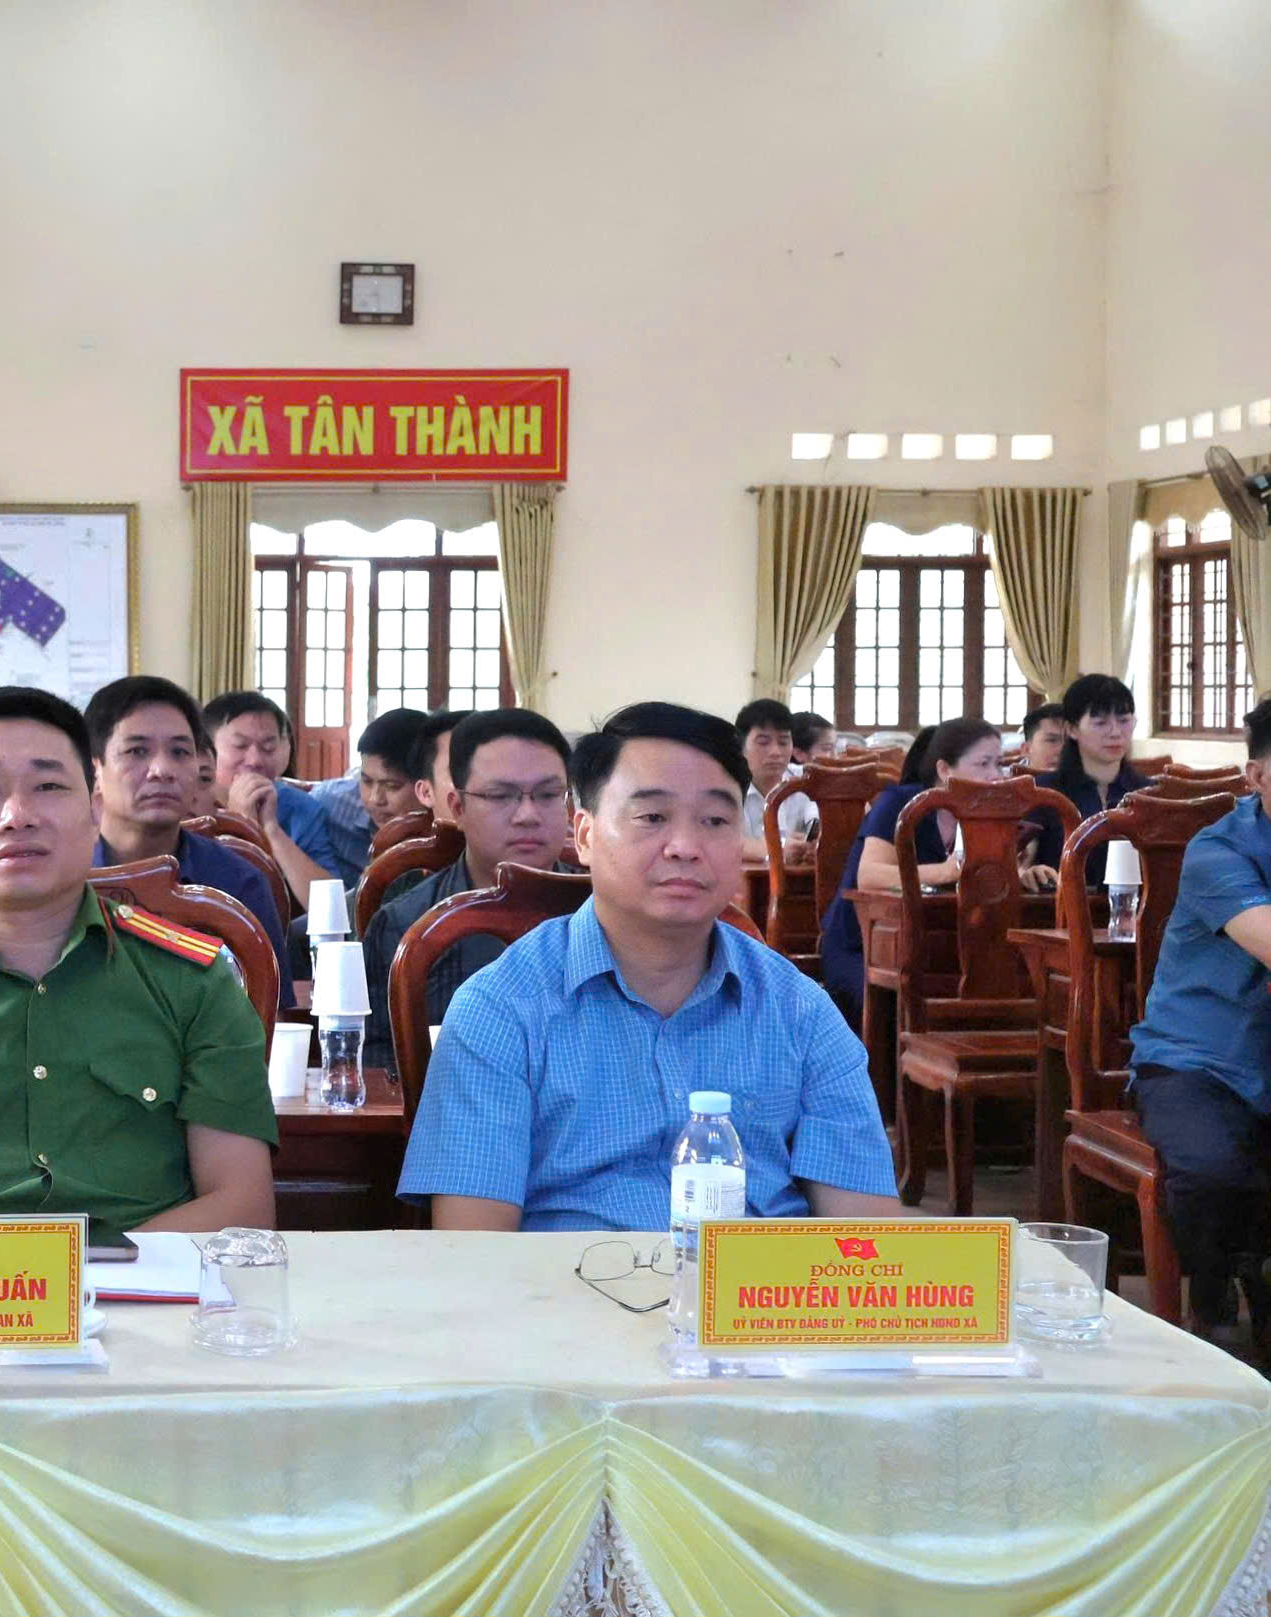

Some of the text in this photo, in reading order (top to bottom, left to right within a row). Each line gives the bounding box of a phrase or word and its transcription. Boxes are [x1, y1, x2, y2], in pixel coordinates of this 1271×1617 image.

[206, 394, 543, 456] XÃ TÂN THÀNH
[737, 1278, 974, 1309] NGUYỄN VĂN HÙNG
[17, 1310, 34, 1328] XÃ
